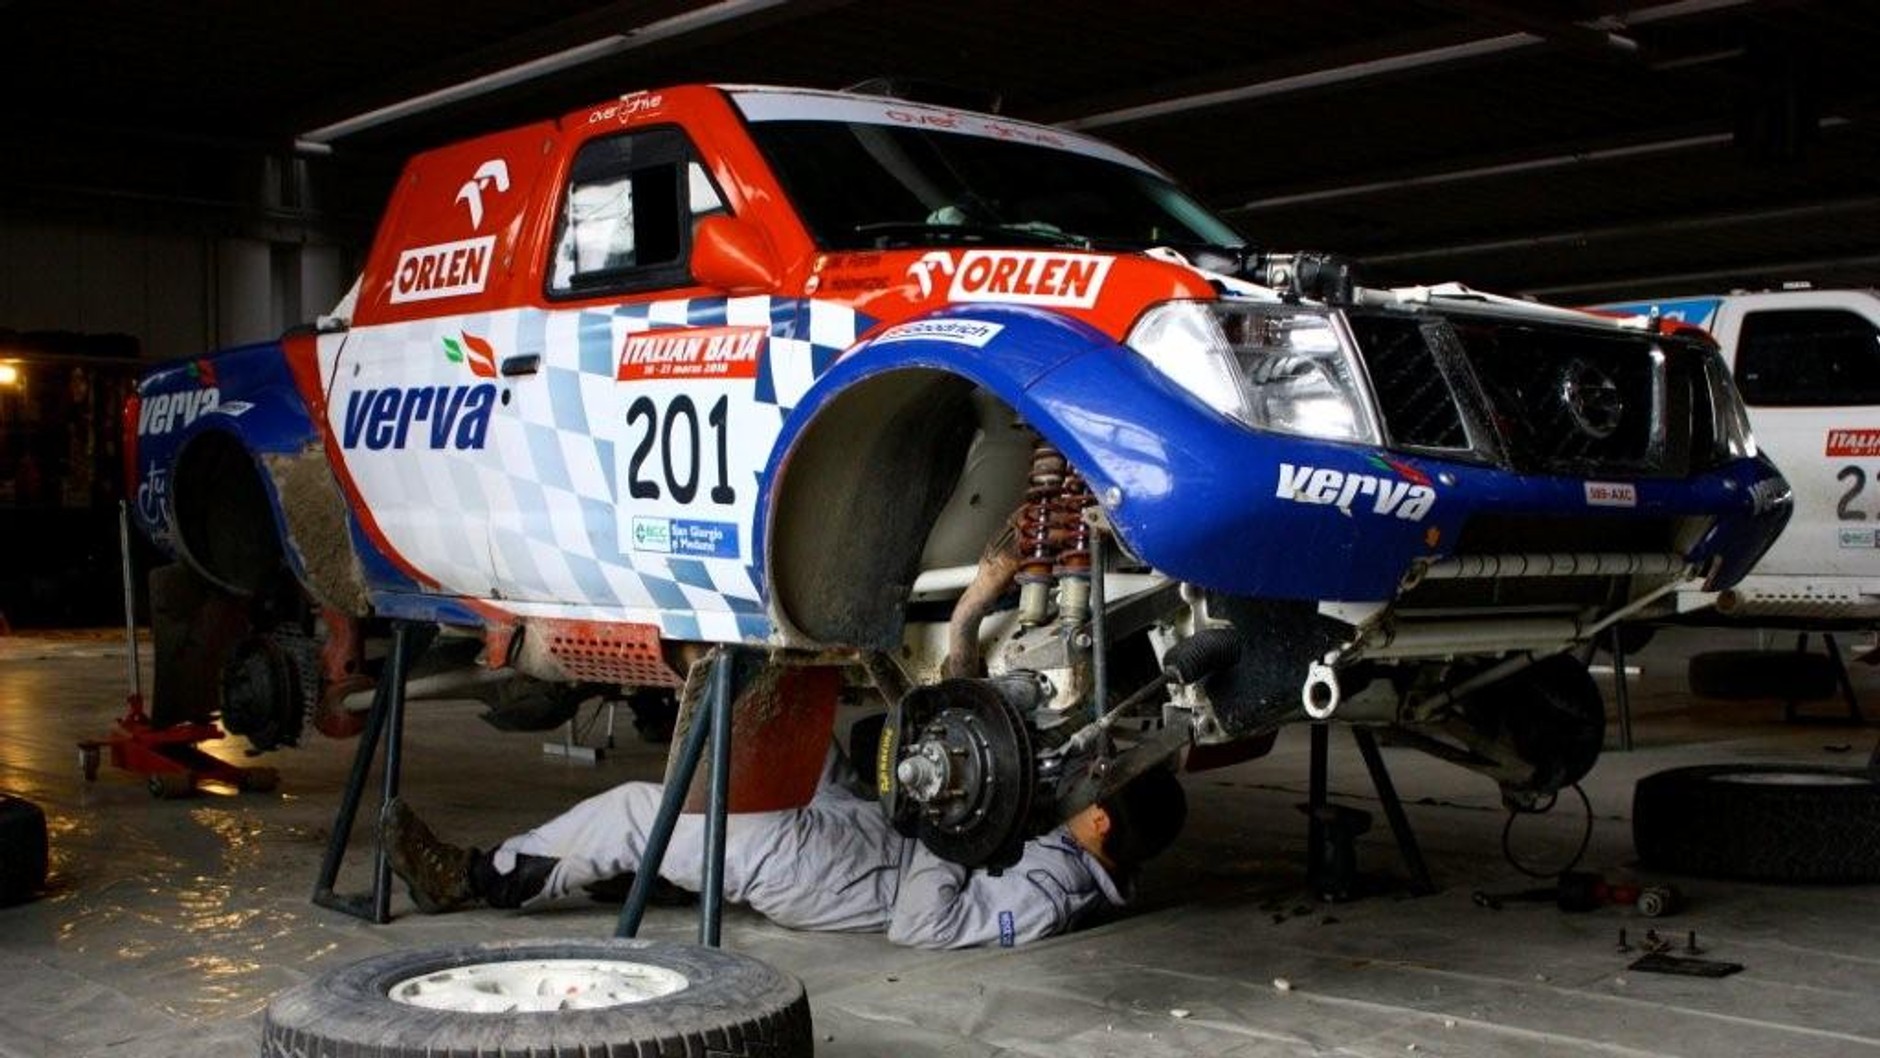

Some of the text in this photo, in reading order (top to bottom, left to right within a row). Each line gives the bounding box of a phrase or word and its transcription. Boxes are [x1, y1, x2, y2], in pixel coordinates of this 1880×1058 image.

[400, 245, 486, 294] ORLEN
[962, 256, 1100, 298] ORLEN
[622, 331, 761, 364] ITALIAN BAJA
[137, 387, 220, 436] verva
[343, 383, 497, 451] verva
[626, 394, 736, 505] 201
[1276, 463, 1436, 522] verva
